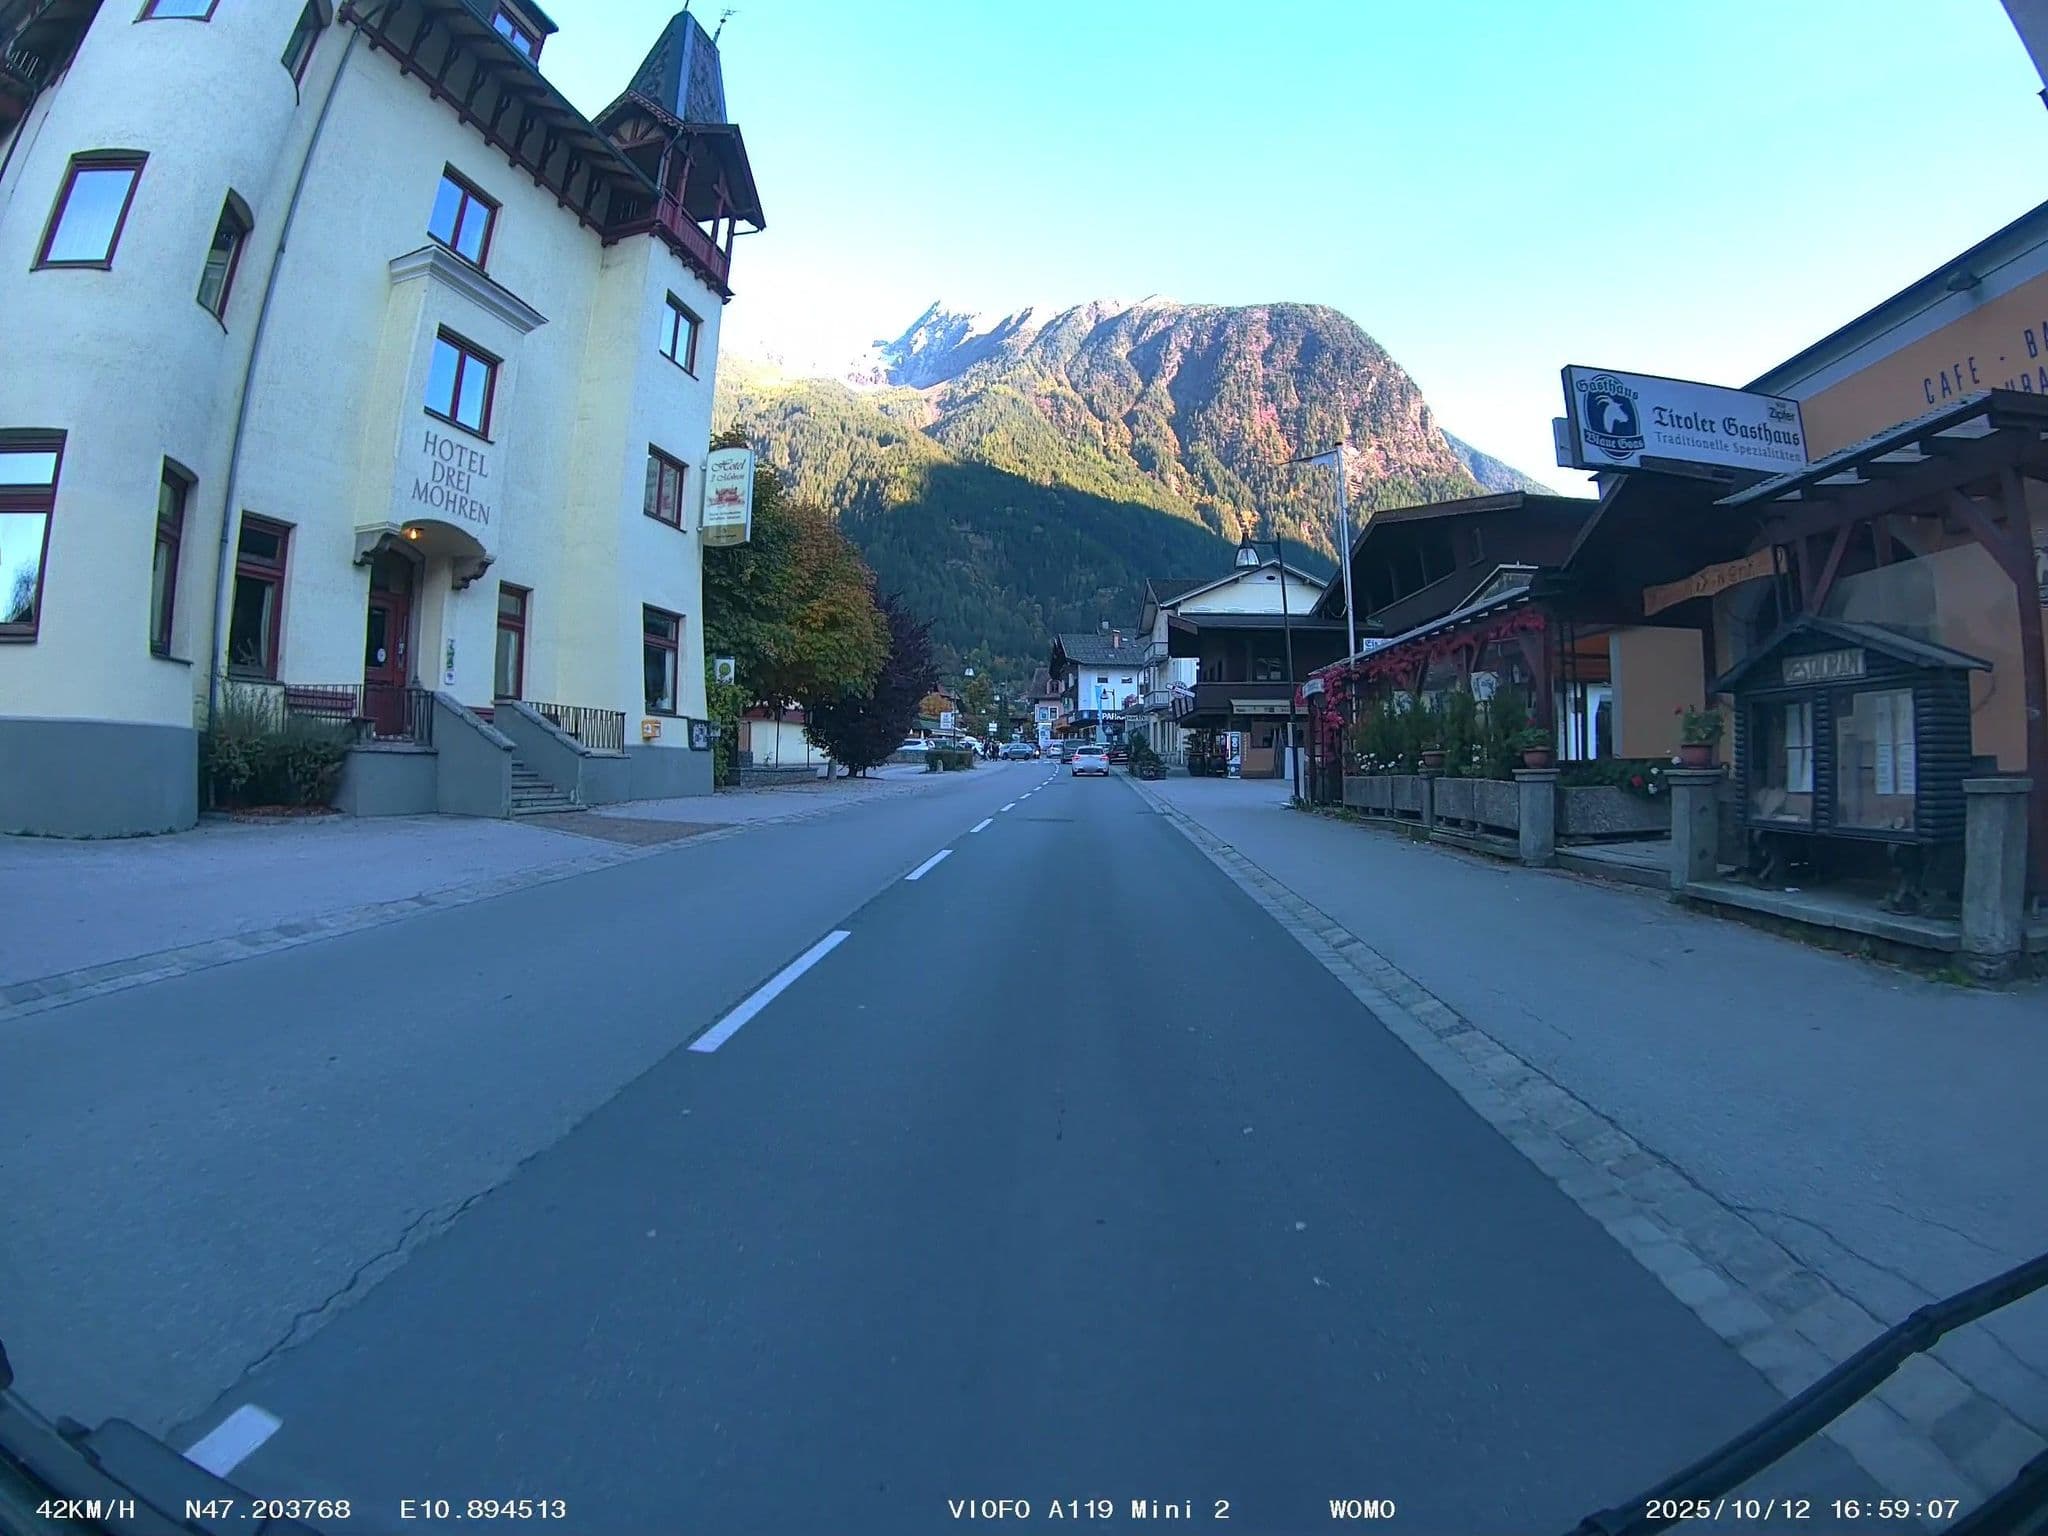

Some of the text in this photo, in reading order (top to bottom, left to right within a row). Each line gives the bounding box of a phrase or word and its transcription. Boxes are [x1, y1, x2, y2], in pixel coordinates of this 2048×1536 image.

[1576, 379, 1639, 400] Gasthaus
[1923, 356, 1980, 404] CAFE
[1653, 406, 1800, 446] Tiroler Gasthaus
[1655, 431, 1729, 452] Traditionelle
[423, 431, 489, 478] HOTEL
[431, 461, 471, 494] DREI
[411, 478, 490, 525] MOHREN
